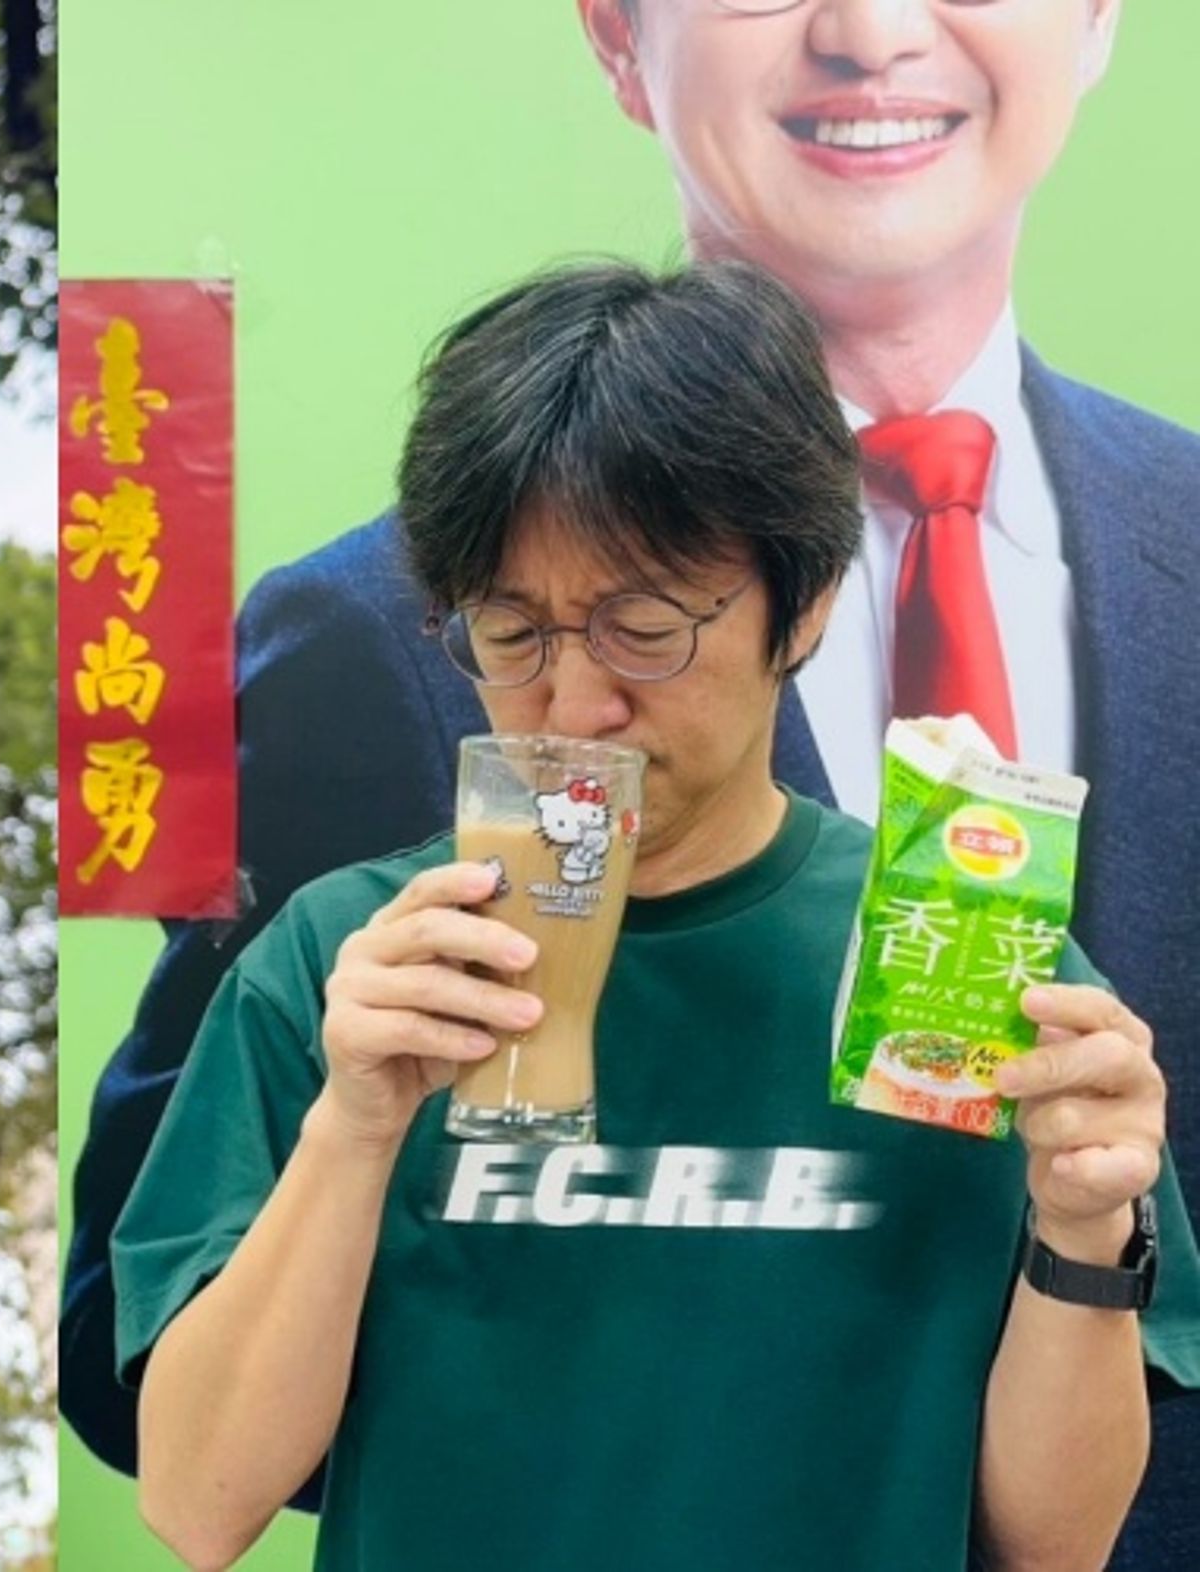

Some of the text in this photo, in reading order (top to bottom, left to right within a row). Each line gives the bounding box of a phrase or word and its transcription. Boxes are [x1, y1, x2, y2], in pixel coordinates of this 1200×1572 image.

[62, 316, 169, 884] 臺灣尚勇
[873, 897, 1067, 992] 香菜
[438, 1142, 883, 1230] F.C.R.B.
